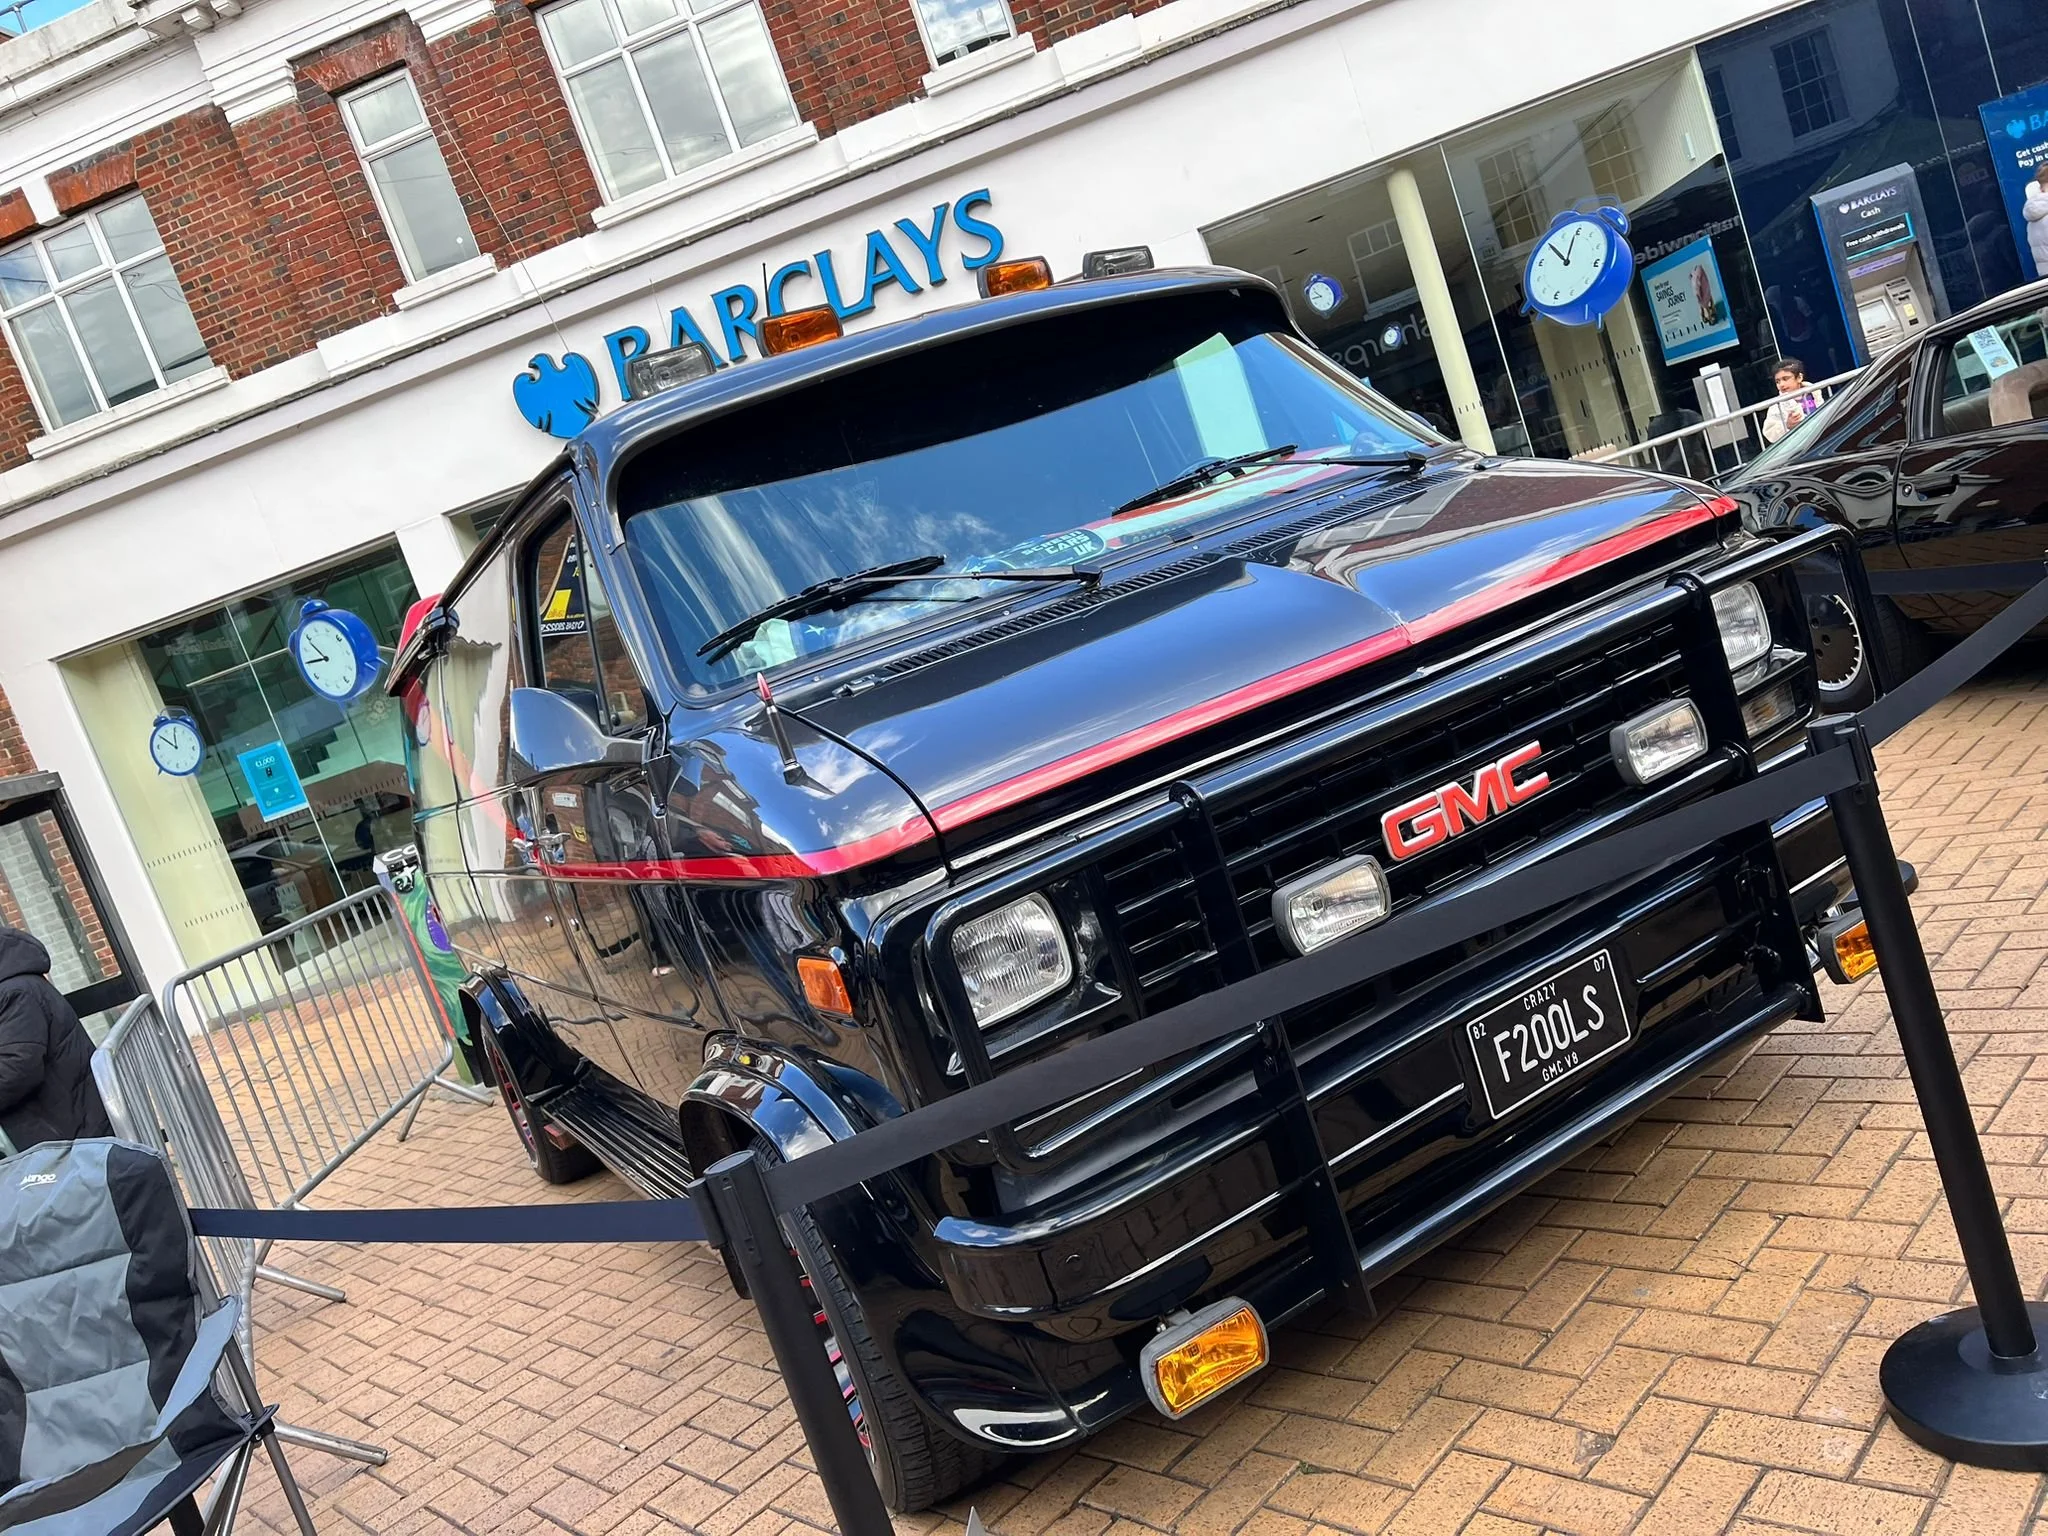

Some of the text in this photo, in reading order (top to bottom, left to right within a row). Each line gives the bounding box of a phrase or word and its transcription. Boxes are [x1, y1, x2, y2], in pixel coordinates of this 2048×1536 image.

[2015, 148, 2031, 159] Get
[2018, 157, 2034, 168] Pay
[2035, 154, 2044, 162] in
[1850, 186, 1897, 210] BARCLAYS
[1860, 206, 1881, 218] Cash
[603, 187, 1004, 402] BARCLAYS
[1655, 286, 1674, 302] SAVINGS
[1668, 291, 1687, 308] JOURNEY
[1044, 534, 1090, 555] CARS
[1073, 540, 1098, 557] UK
[1380, 739, 1550, 862] GMC
[1593, 955, 1606, 973] 07
[1523, 982, 1557, 1011] CRAZY
[1472, 1022, 1487, 1040] 82
[1541, 1051, 1579, 1082] GMC V8
